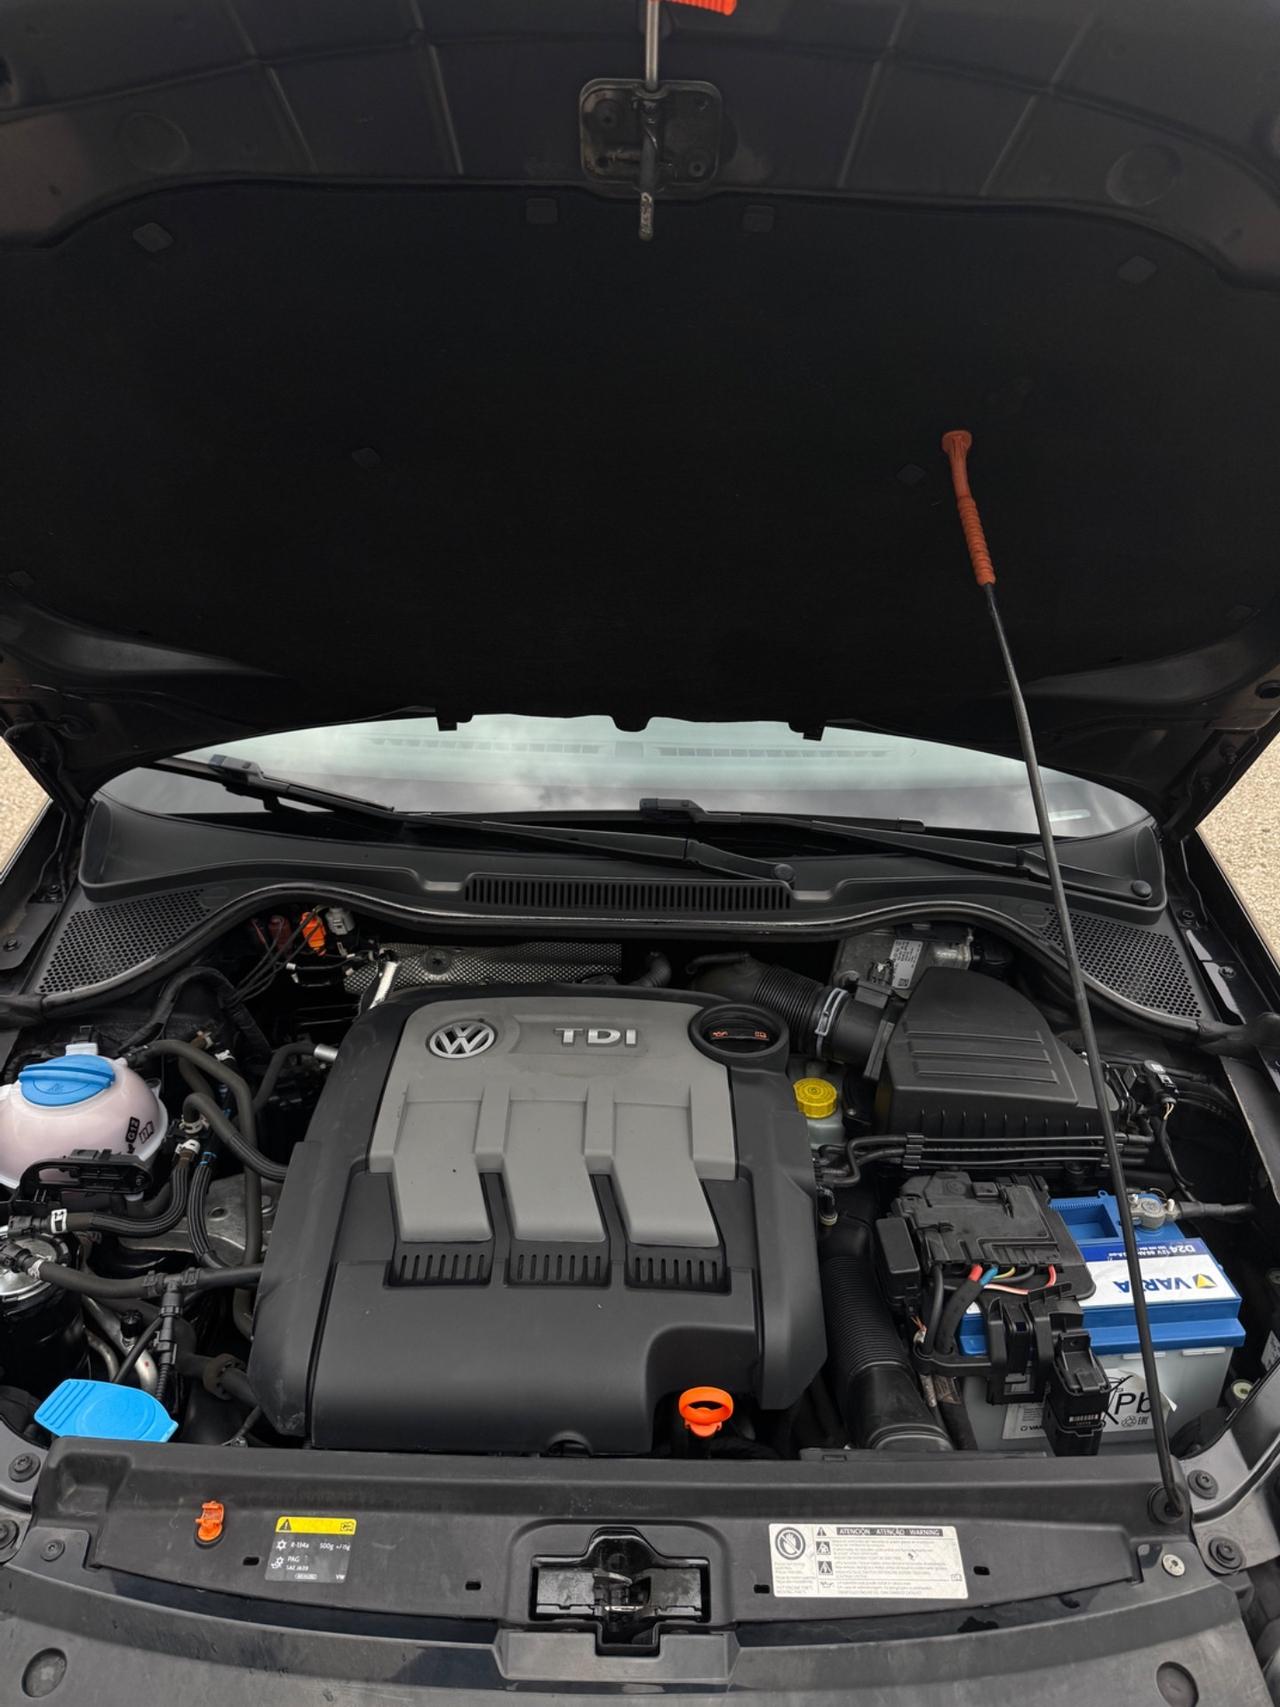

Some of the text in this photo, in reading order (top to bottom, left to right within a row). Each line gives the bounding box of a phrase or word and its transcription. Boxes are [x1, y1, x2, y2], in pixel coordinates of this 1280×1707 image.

[554, 1027, 637, 1047] TDI
[1113, 1276, 1191, 1293] VARA
[1114, 1392, 1152, 1415] Pb
[839, 1527, 870, 1536] ATENCIÓN
[909, 1528, 940, 1536] WARNING
